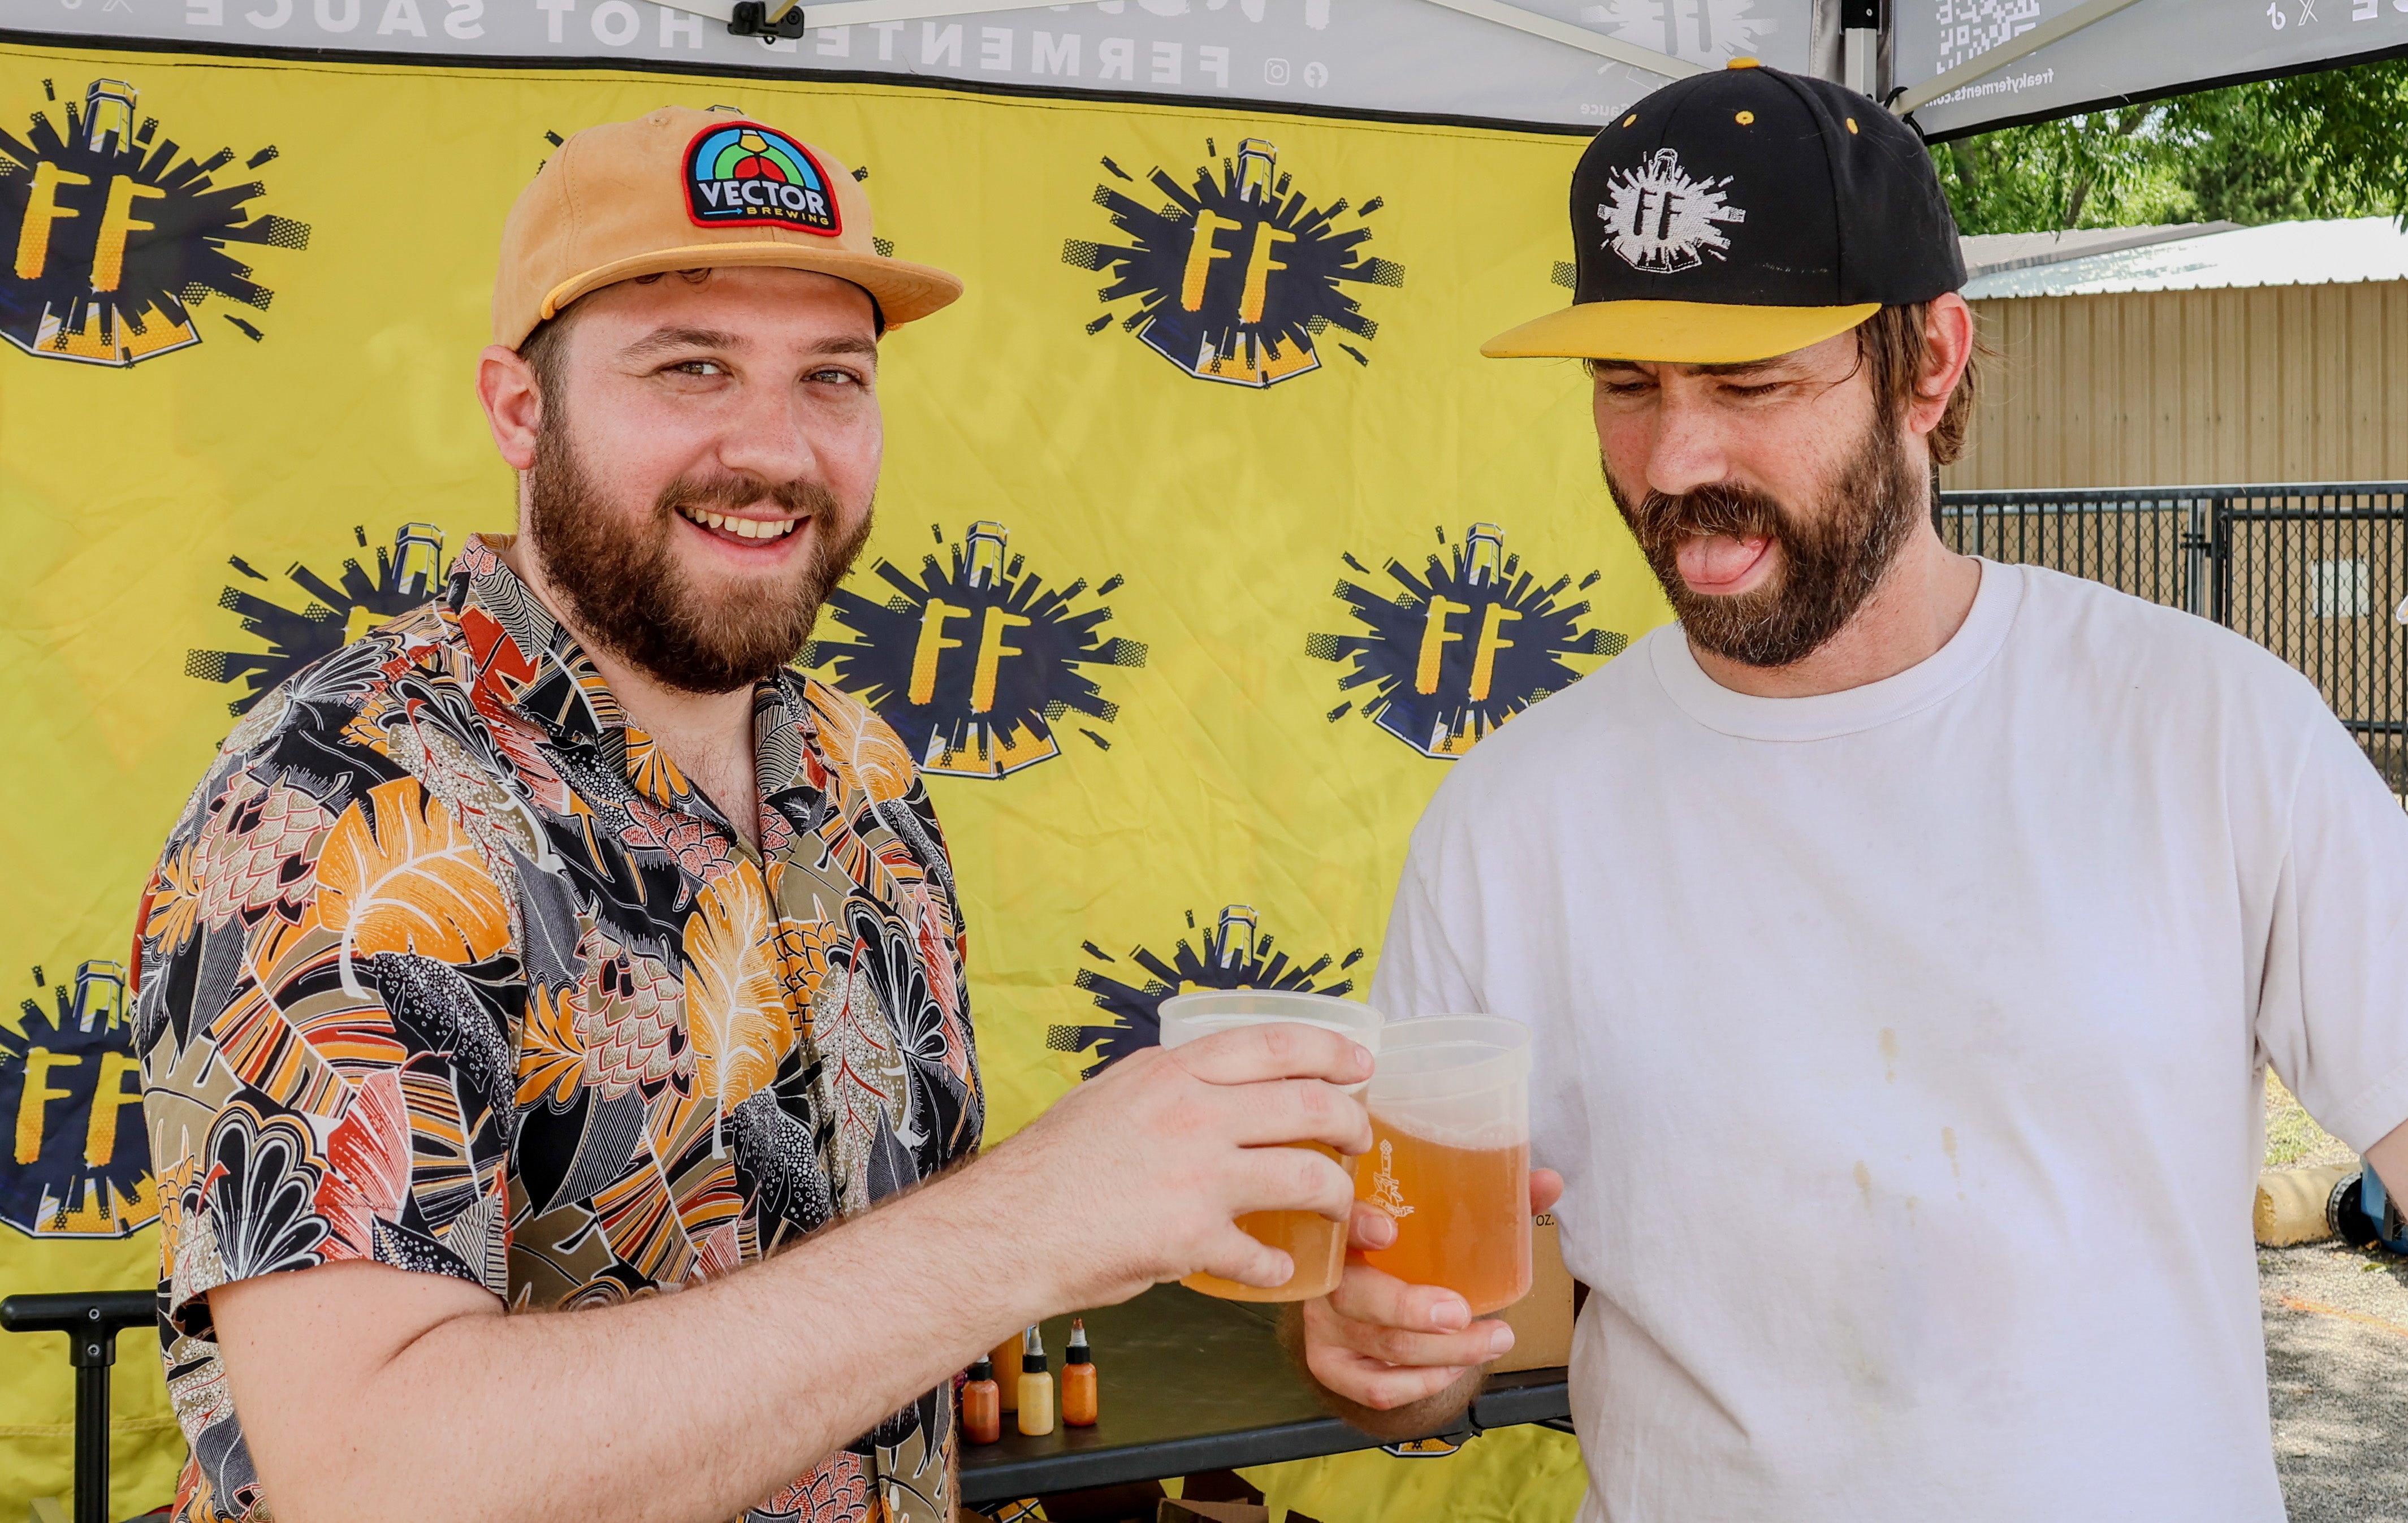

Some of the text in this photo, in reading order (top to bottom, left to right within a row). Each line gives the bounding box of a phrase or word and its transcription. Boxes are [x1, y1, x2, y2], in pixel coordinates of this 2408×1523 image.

[14, 161, 166, 292] FF
[698, 180, 827, 216] VECTOR
[747, 207, 829, 225] BREWING
[1633, 188, 1685, 240] FF
[1181, 209, 1296, 323] FF
[907, 598, 1031, 713] FF
[1415, 595, 1523, 701] FF
[14, 1046, 144, 1168] FF
[1536, 1214, 1554, 1226] OZ.
